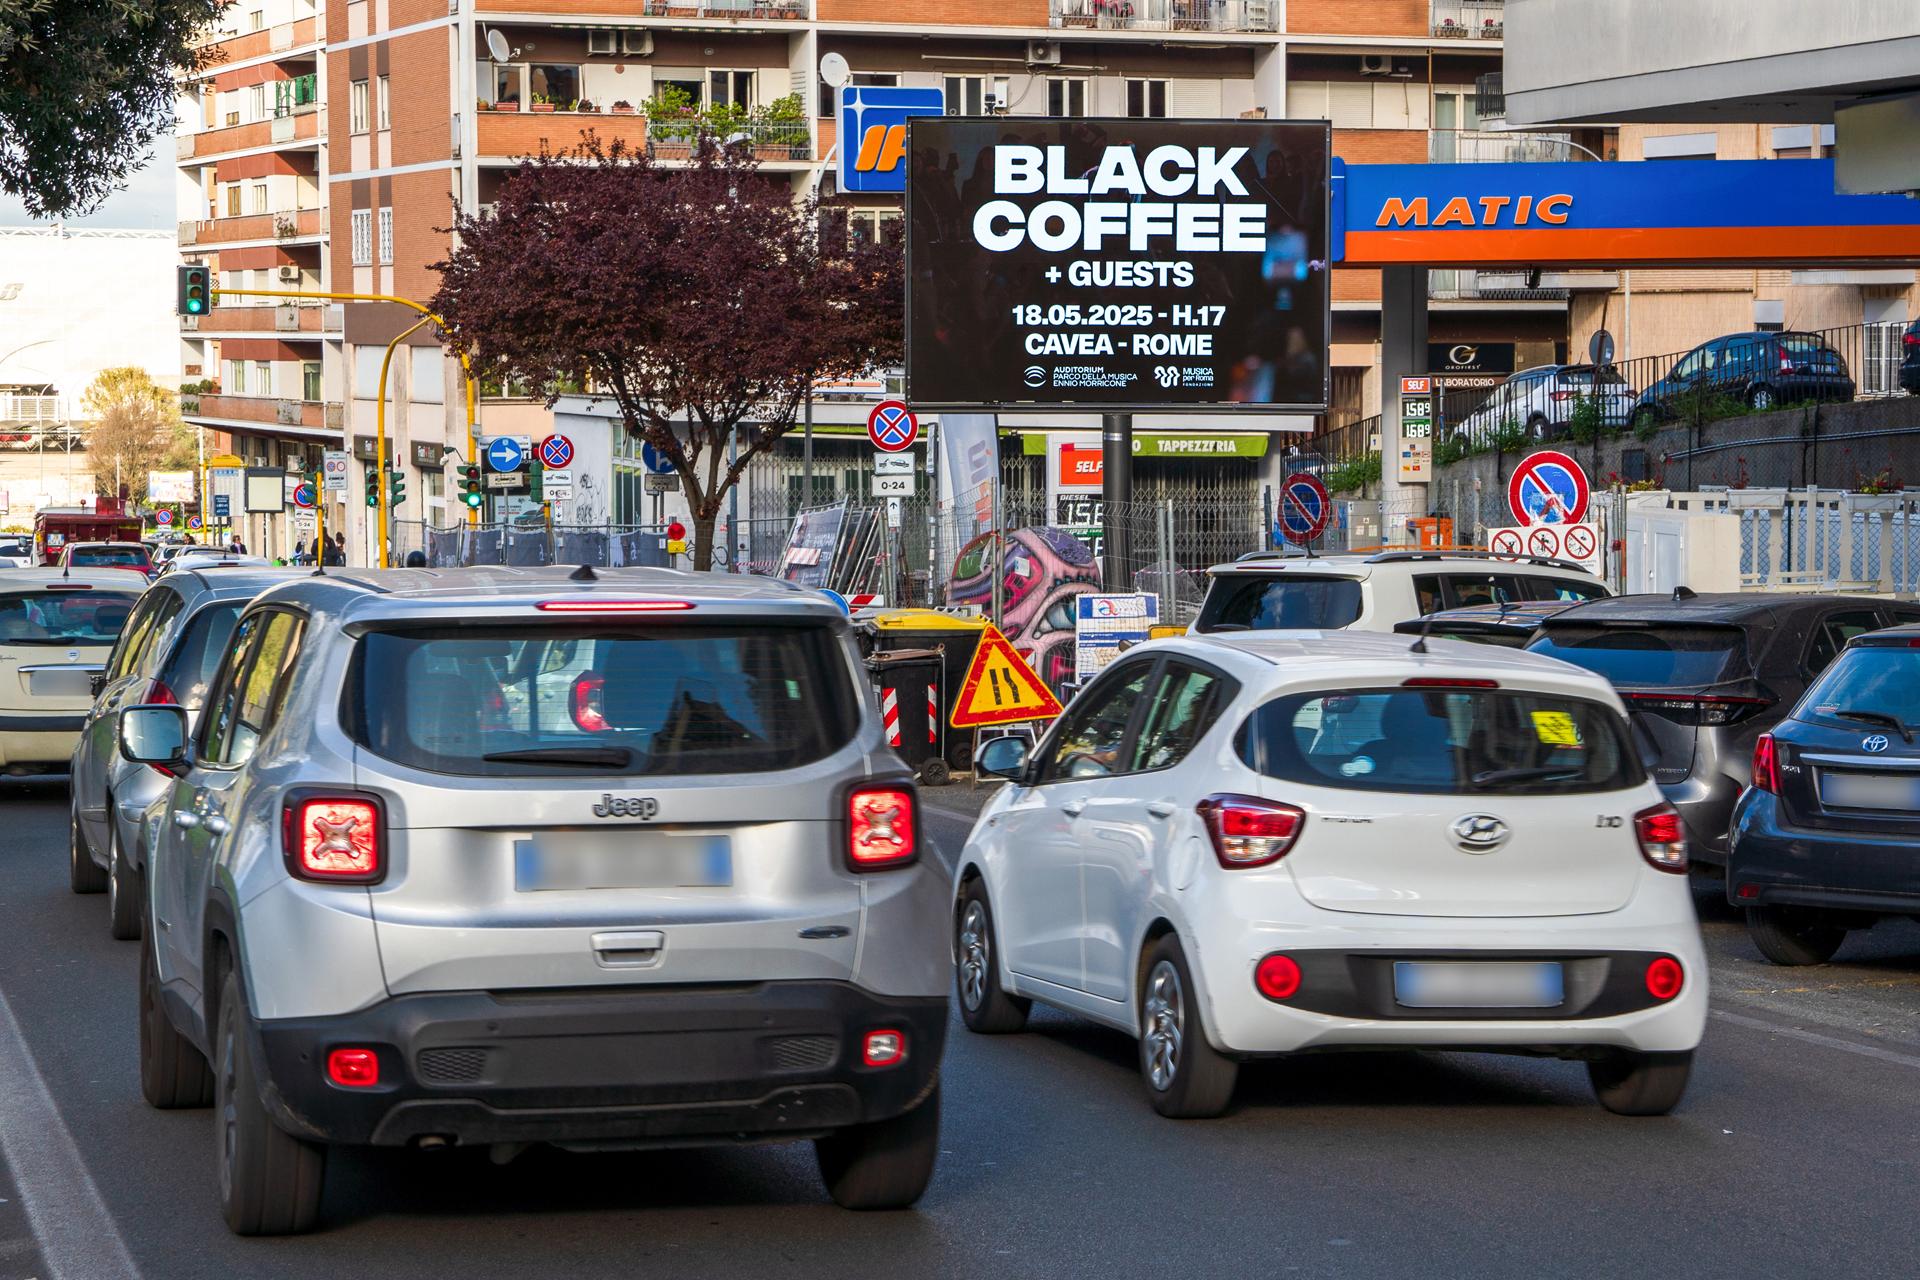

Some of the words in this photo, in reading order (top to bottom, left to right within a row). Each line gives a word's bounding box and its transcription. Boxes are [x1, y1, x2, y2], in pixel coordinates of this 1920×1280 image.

[994, 145, 1250, 197] BLACK
[1375, 194, 1574, 227] MATIC
[972, 199, 1267, 252] COFFEE
[1068, 261, 1194, 288] GUESTS
[1011, 305, 1154, 326] 18.05.2025
[1172, 305, 1226, 326] H.17
[1025, 333, 1115, 356] CAVEA
[1132, 333, 1213, 356] ROME
[1053, 366, 1104, 374] AUDITORIUM
[1053, 373, 1081, 381] PARCO
[1082, 373, 1107, 381] DELLA
[1107, 373, 1138, 381] MUSICA
[1182, 367, 1214, 375] MUSICA
[1407, 381, 1425, 390] SELF
[1075, 460, 1103, 473] SELF
[881, 481, 906, 491] 0-24
[591, 793, 660, 821] Jeep
